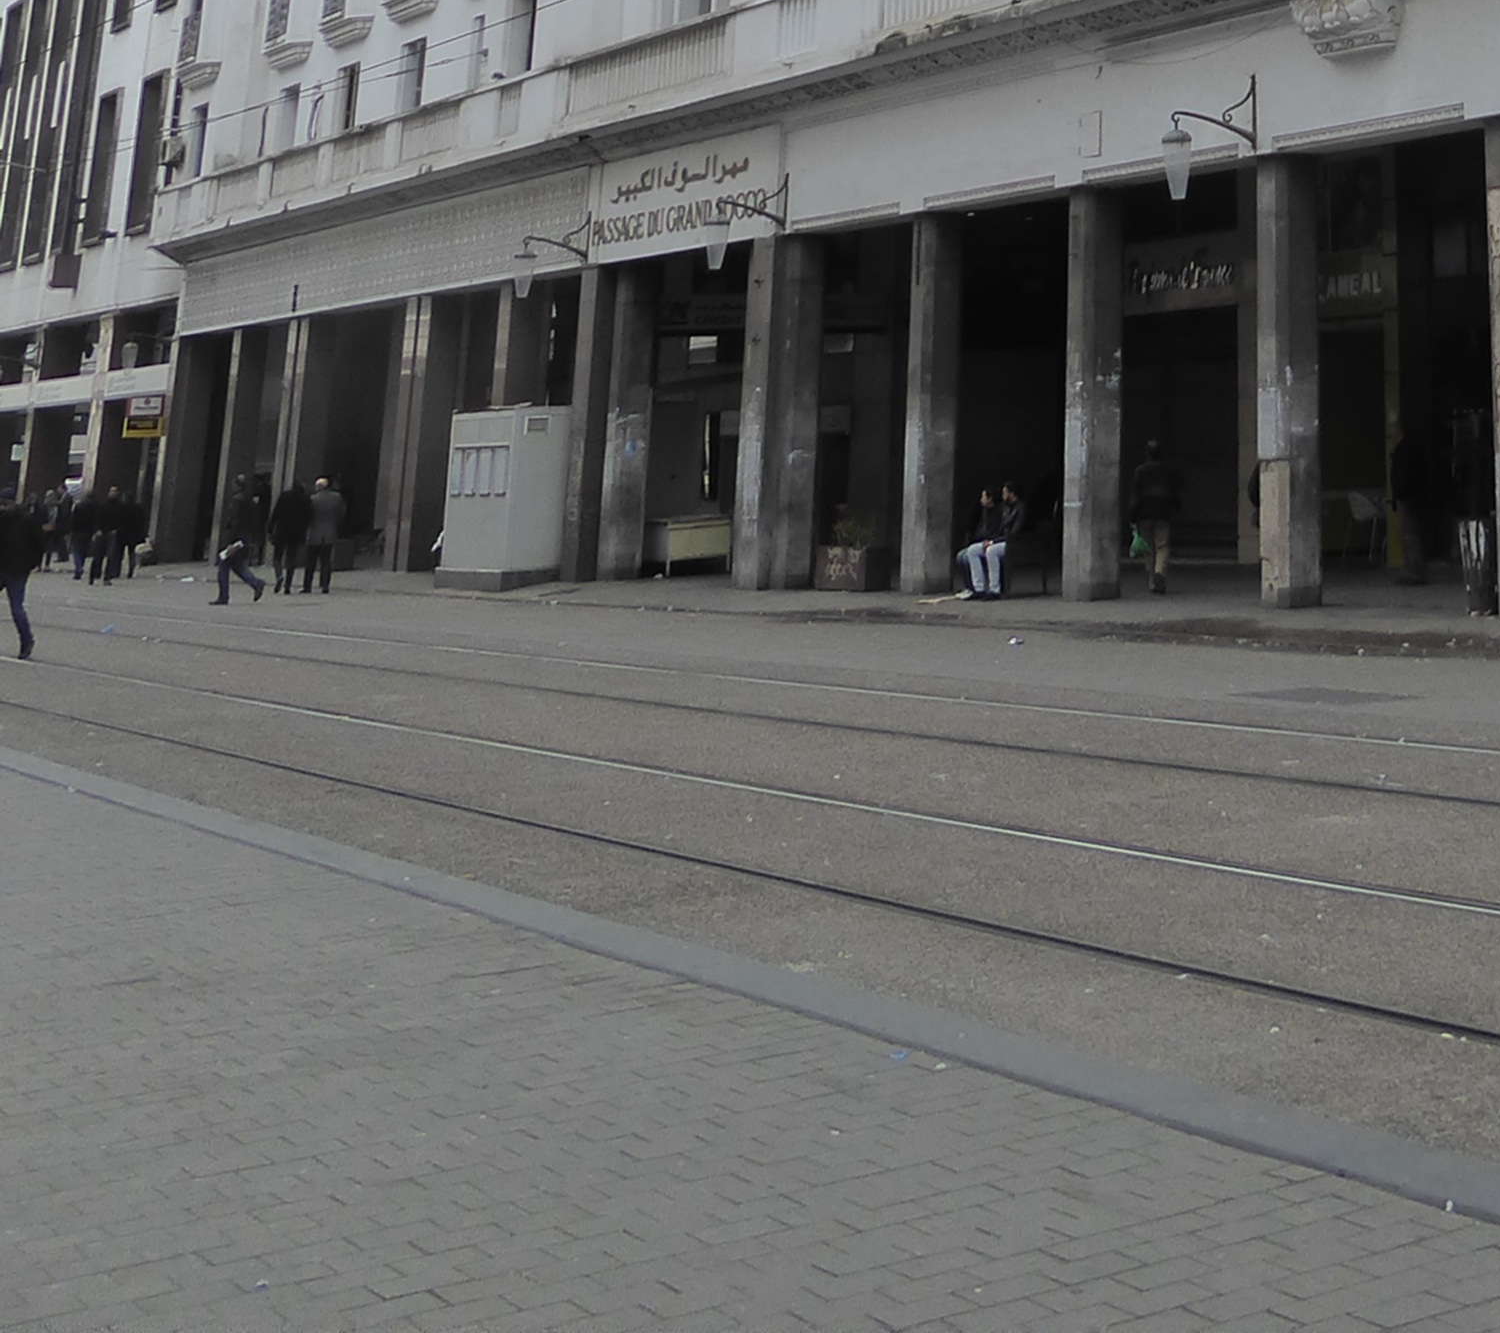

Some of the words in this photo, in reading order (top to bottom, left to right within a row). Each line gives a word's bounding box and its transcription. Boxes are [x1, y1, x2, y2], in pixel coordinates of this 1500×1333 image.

[592, 211, 646, 247] PASSAGE
[646, 207, 666, 238] DU
[666, 199, 713, 233] GRAND
